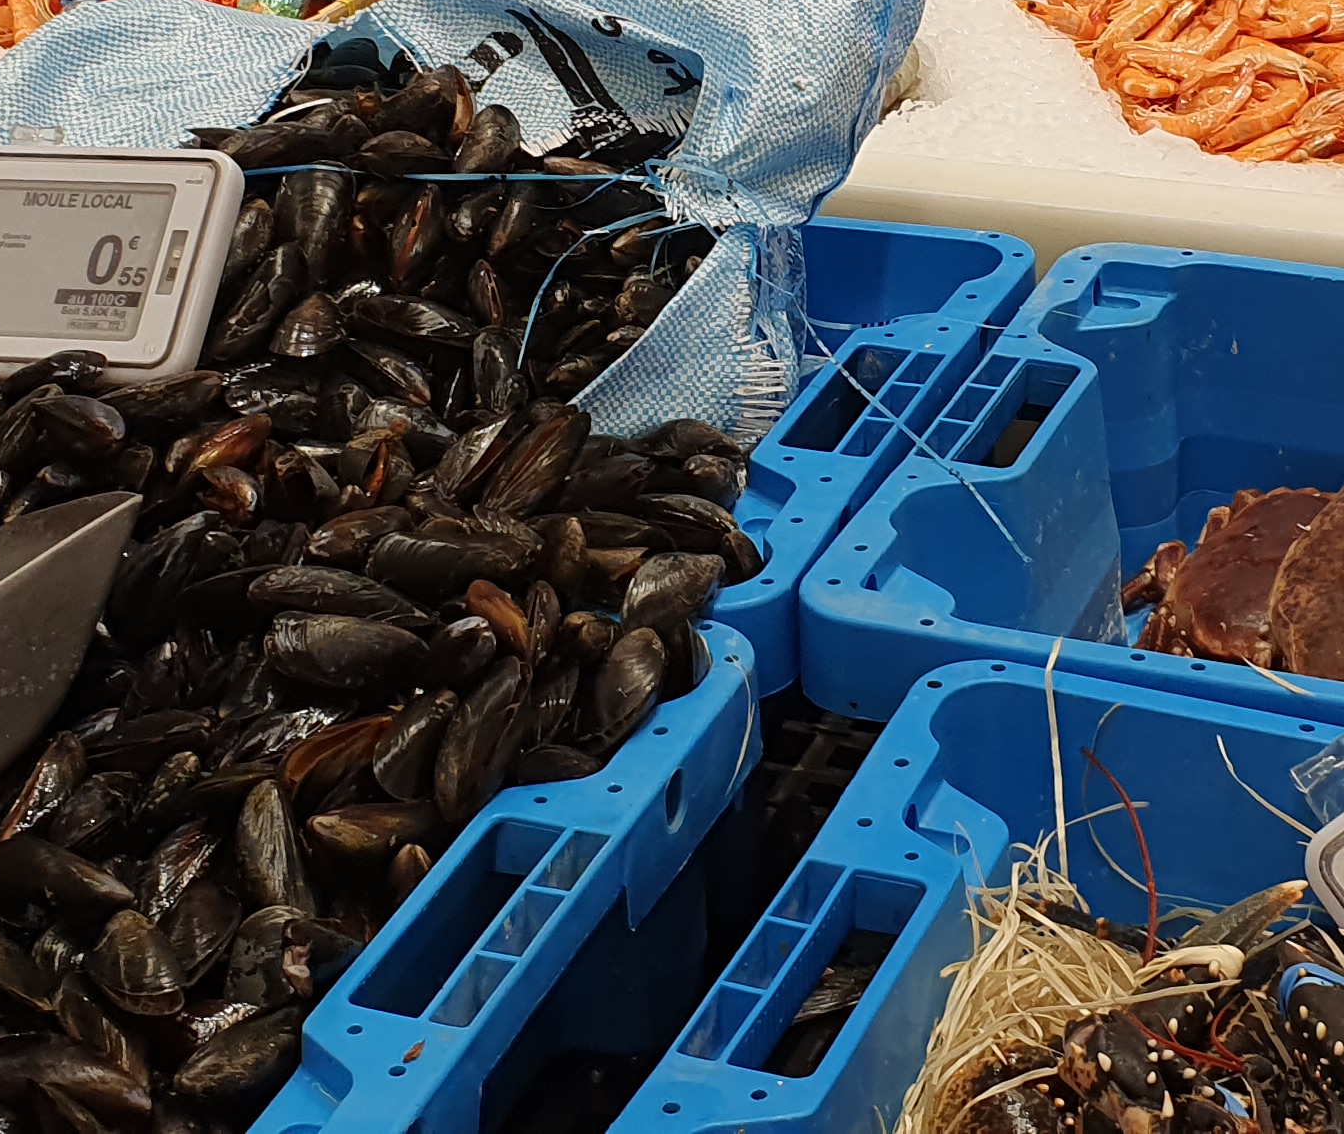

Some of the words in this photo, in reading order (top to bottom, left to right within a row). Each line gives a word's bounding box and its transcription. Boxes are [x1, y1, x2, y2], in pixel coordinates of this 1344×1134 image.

[23, 191, 79, 208] MOULE
[81, 194, 134, 210] LOCAL
[86, 234, 123, 285] 0
[117, 266, 147, 286] 55
[68, 294, 87, 305] au
[90, 293, 128, 307] 100G
